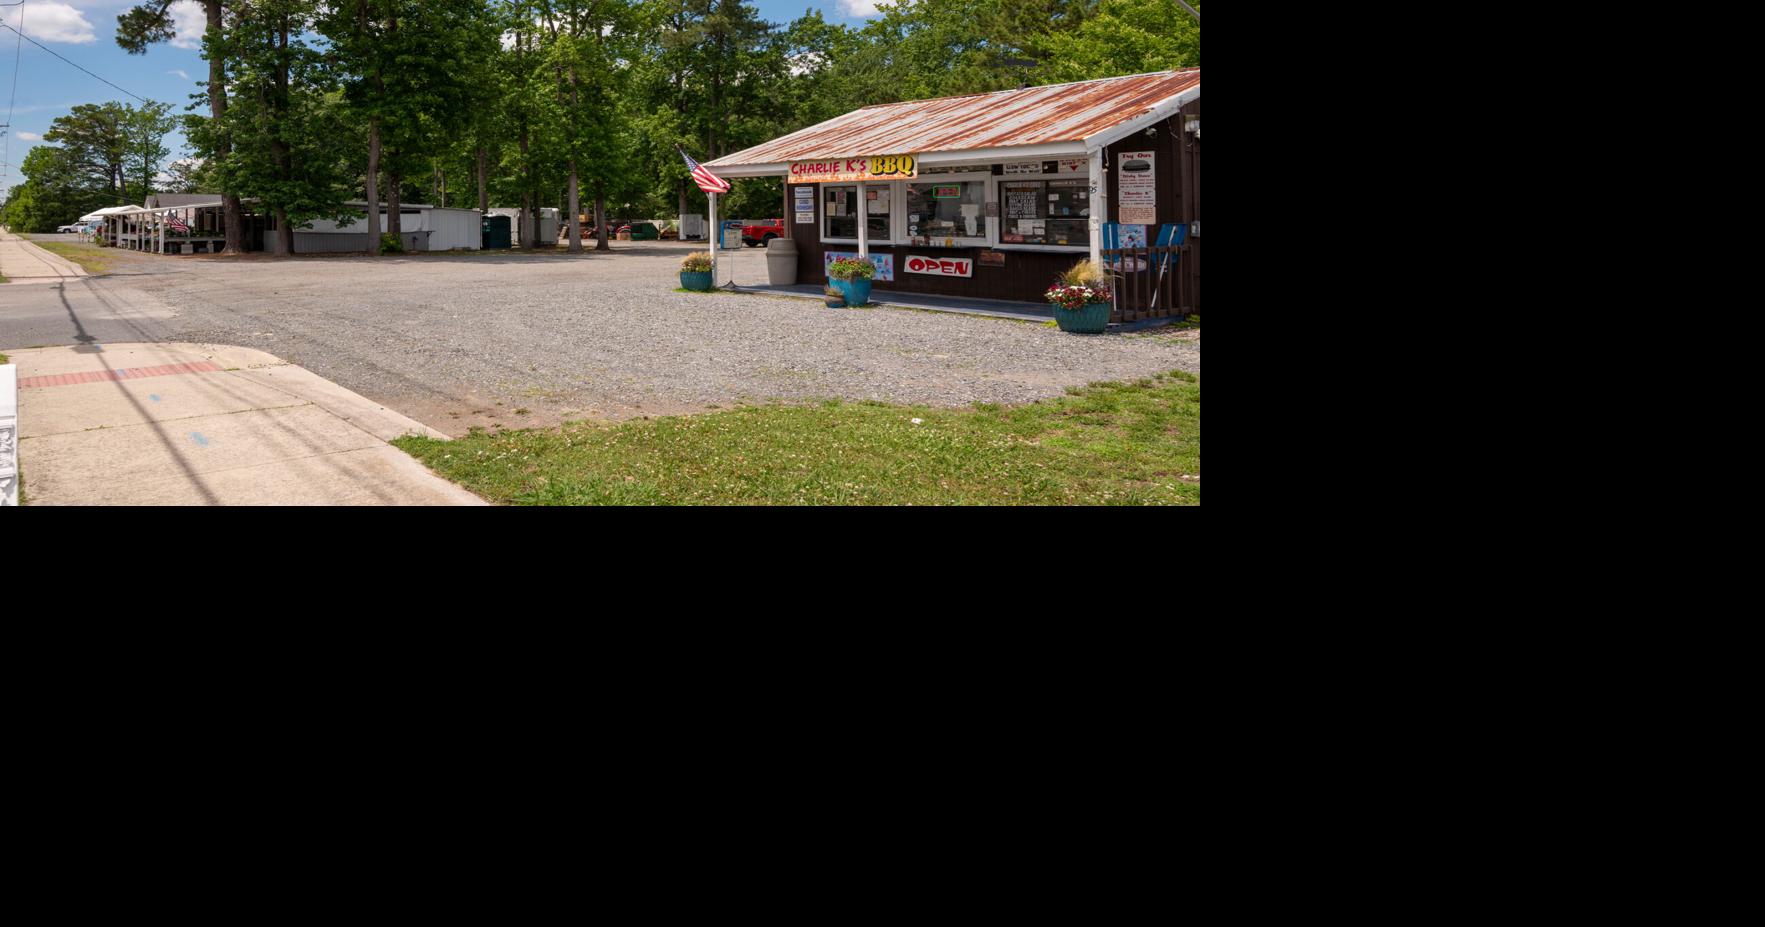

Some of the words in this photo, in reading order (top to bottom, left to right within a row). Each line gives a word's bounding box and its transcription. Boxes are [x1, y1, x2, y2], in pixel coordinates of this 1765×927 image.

[791, 160, 840, 175] CHARLIE
[870, 155, 914, 177] BBQ
[908, 258, 969, 275] OPEN
